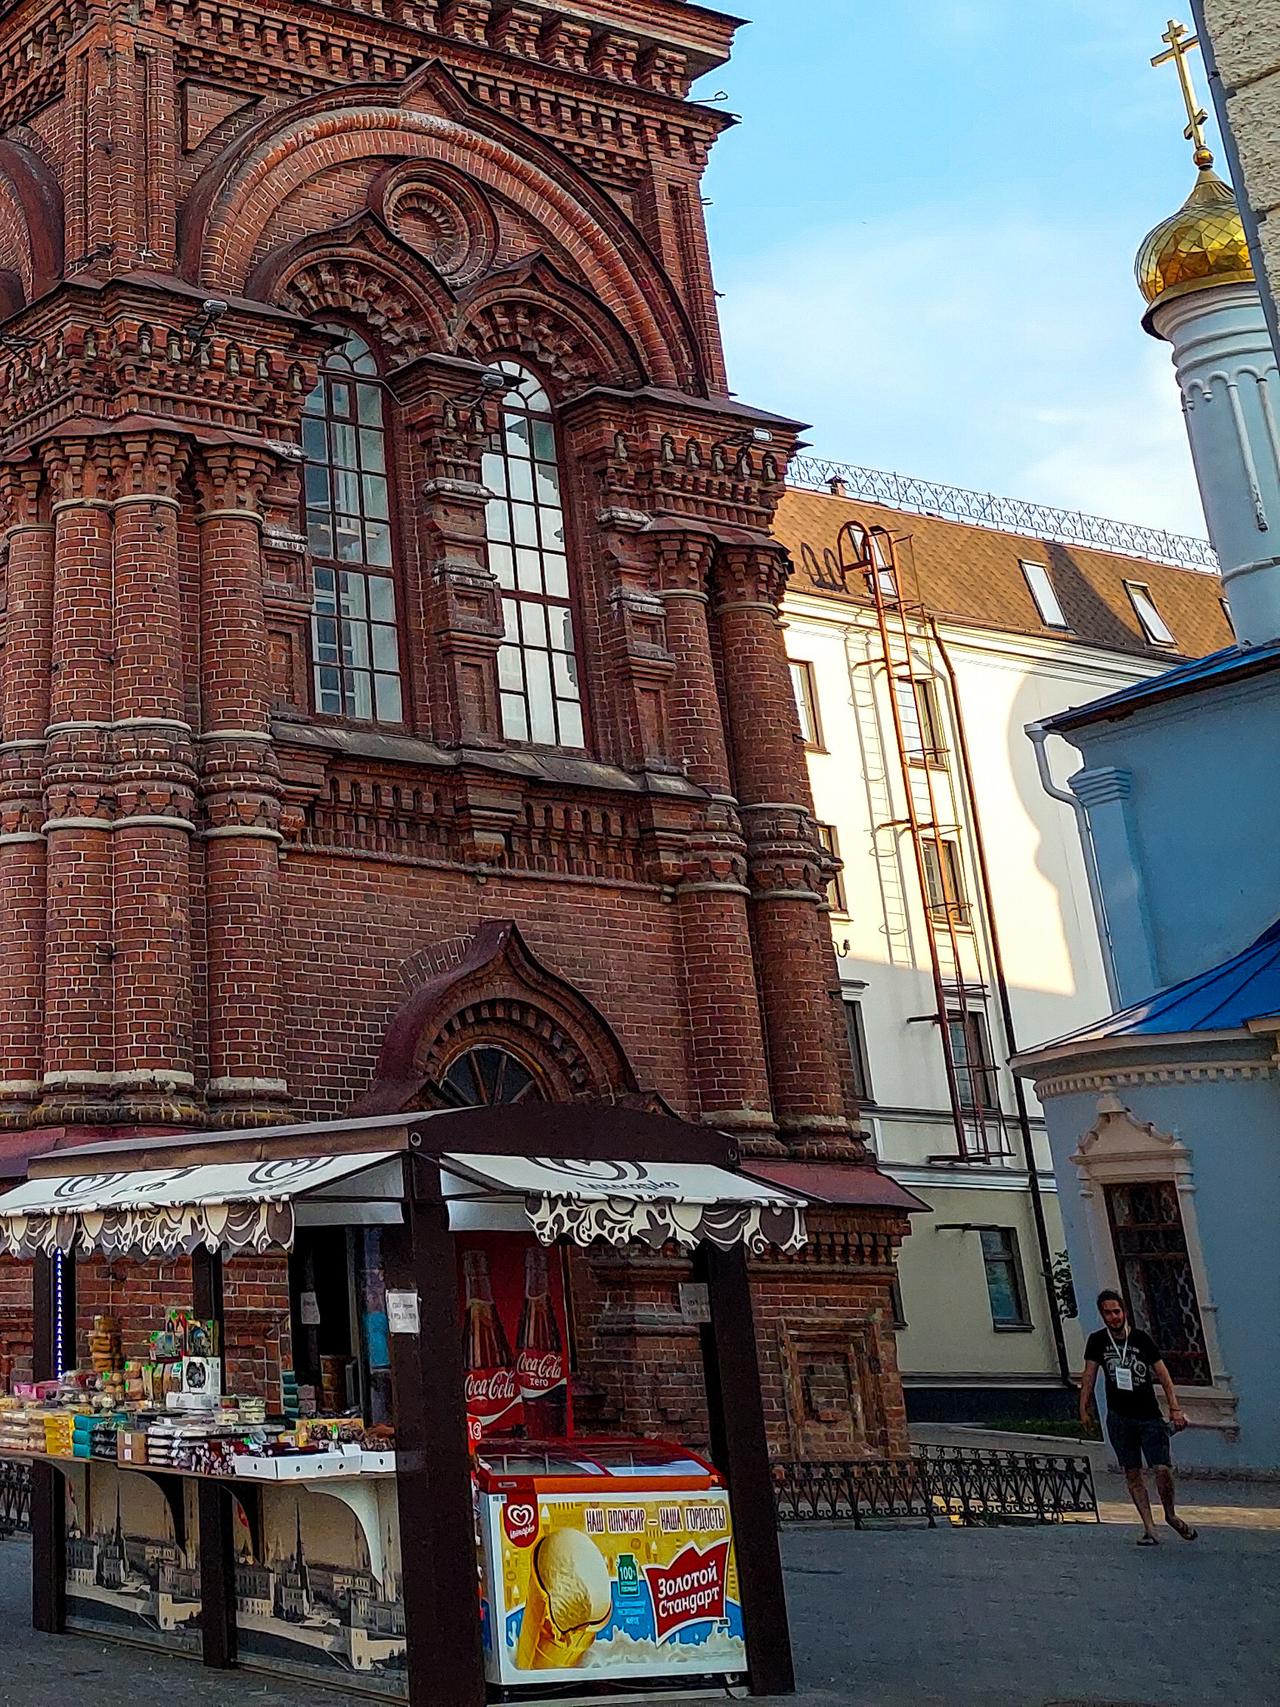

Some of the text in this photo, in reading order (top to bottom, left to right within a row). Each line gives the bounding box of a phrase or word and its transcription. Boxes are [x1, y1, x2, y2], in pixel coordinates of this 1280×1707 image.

[517, 1351, 562, 1378] Coca-Cola
[464, 1369, 516, 1402] Coca-Cola
[530, 1377, 549, 1387] zero
[586, 1510, 604, 1532] НАШ
[607, 1509, 645, 1532] ПЛОМБИР
[660, 1507, 682, 1530] НАША
[658, 1559, 718, 1599] Золотой
[659, 1586, 720, 1617] Стандарт
